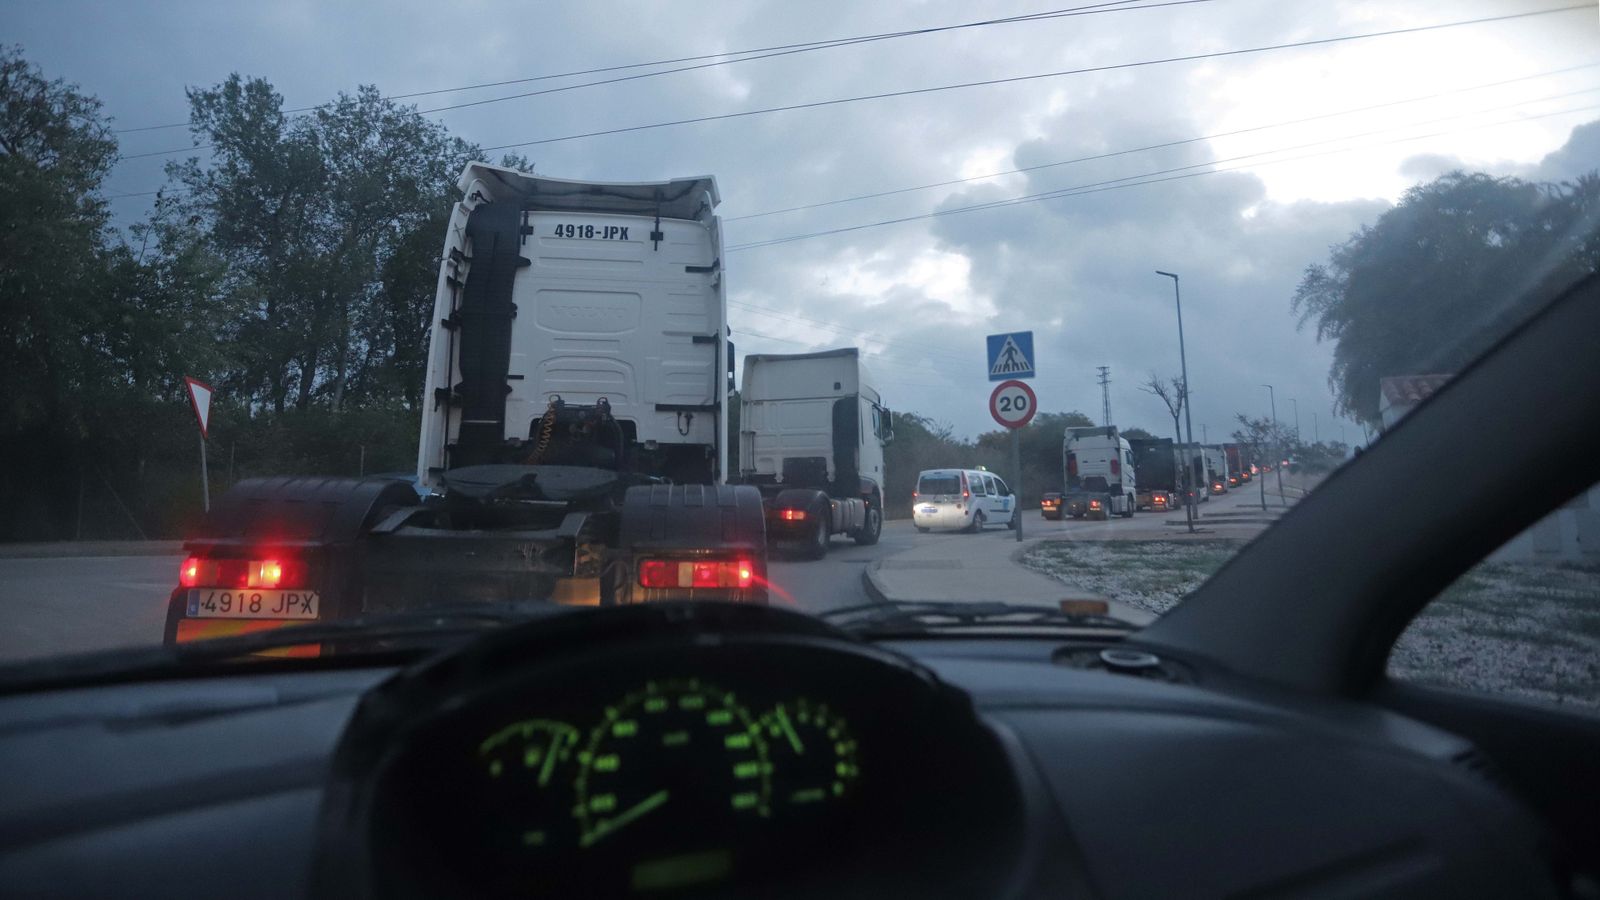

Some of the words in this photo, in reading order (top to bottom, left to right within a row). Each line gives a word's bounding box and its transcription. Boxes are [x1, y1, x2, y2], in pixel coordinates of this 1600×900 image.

[555, 224, 629, 240] 4918-JPX
[1000, 395, 1027, 412] 20
[204, 592, 263, 613] 4918
[272, 593, 315, 614] JPX
